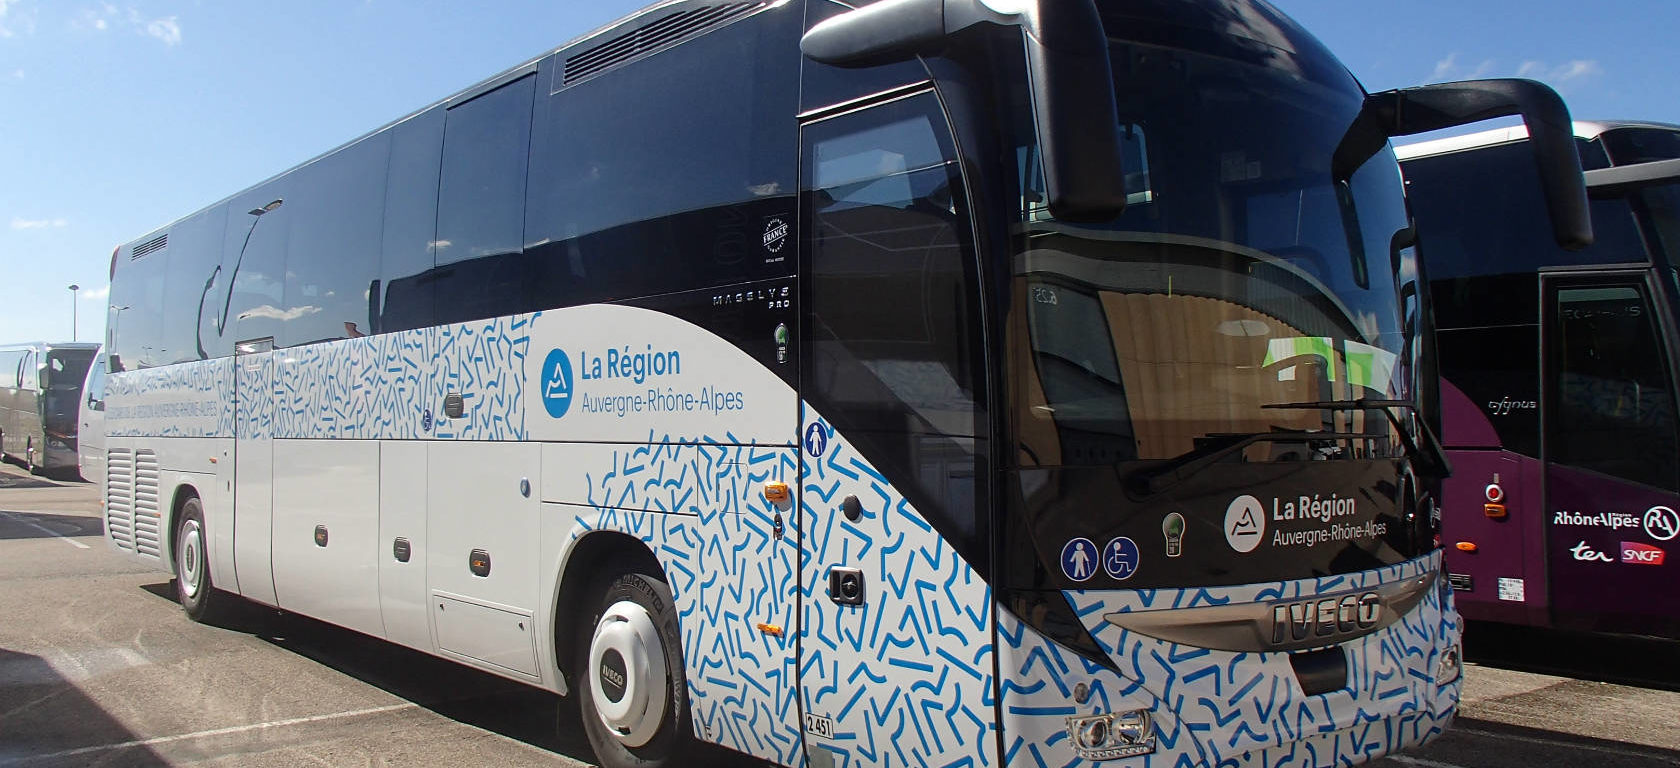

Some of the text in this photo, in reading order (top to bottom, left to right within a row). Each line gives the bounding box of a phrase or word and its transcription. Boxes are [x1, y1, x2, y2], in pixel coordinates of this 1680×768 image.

[763, 224, 788, 244] FRANCE
[713, 286, 790, 307] MAGELYS
[768, 299, 790, 309] PRO
[581, 344, 681, 384] La Région
[582, 385, 744, 418] Auvergne-Rhône-Alpes
[1488, 396, 1537, 415] cygnus
[1273, 493, 1355, 522] La Région
[1272, 519, 1387, 547] Auvergne-Rhône-Alpes
[1569, 540, 1663, 562] ter SNCF
[1271, 592, 1381, 645] IVECO
[602, 664, 623, 686] IVECO
[807, 715, 831, 736] 2 451
